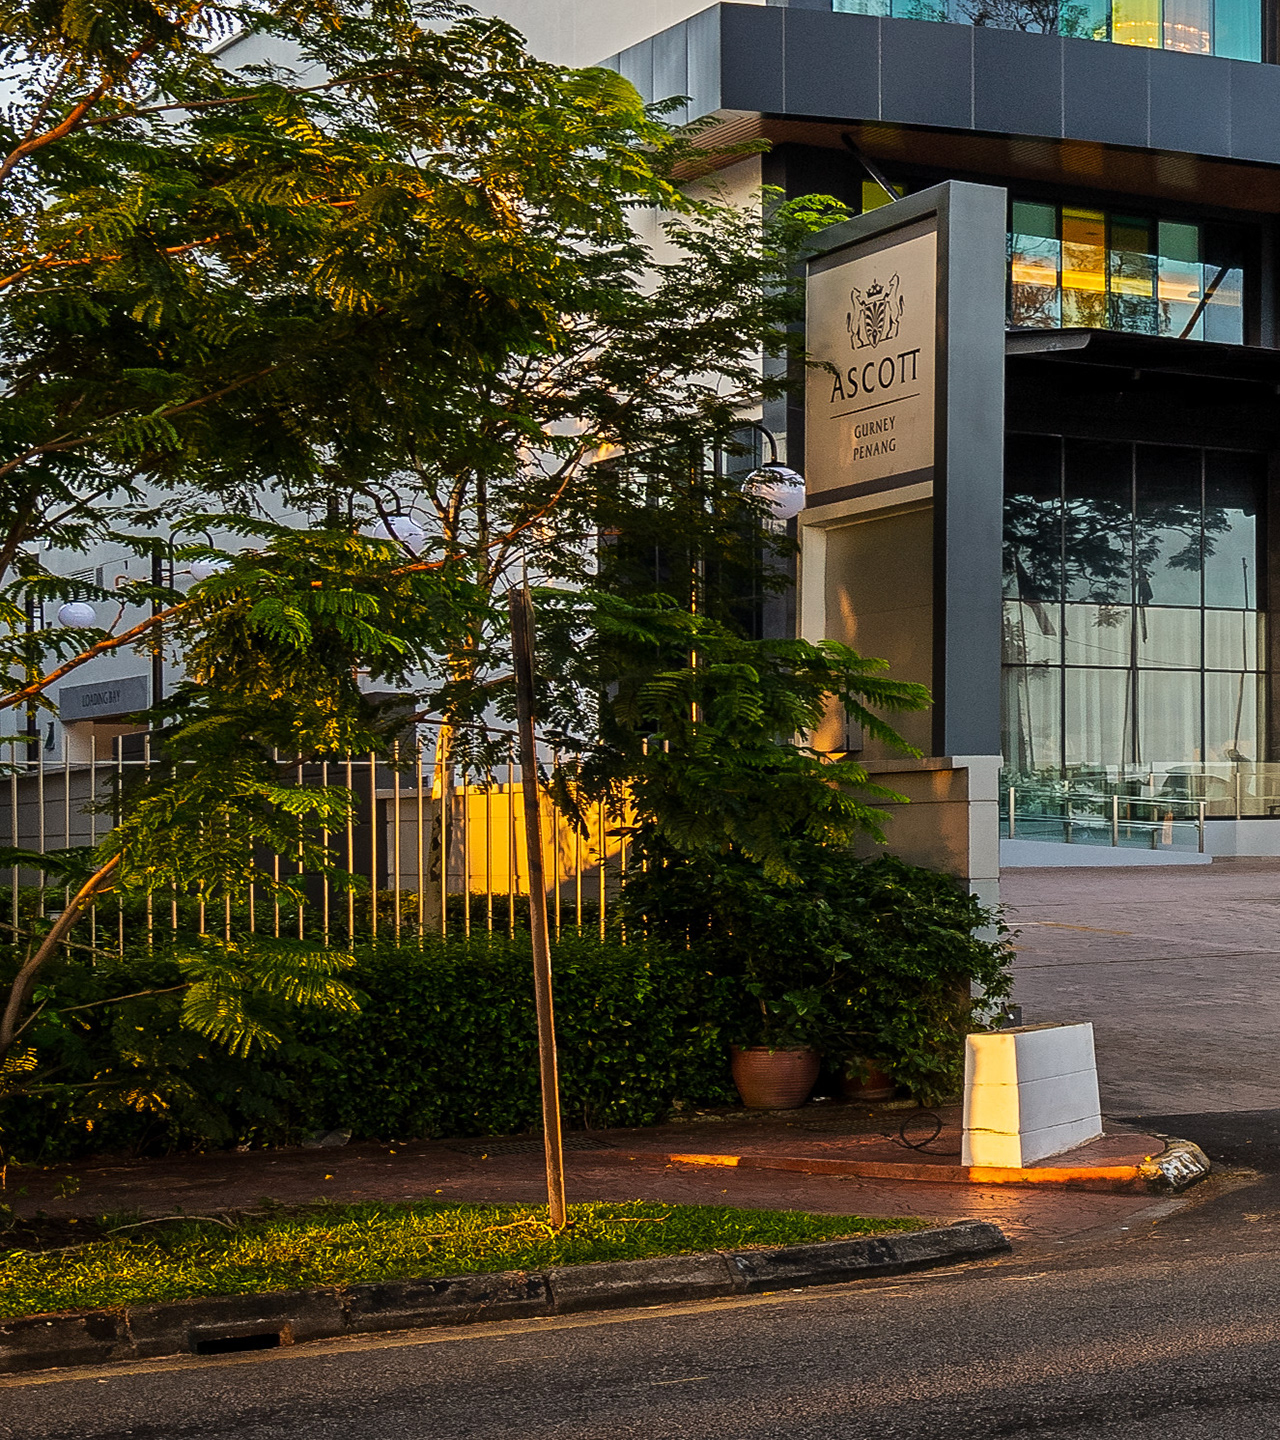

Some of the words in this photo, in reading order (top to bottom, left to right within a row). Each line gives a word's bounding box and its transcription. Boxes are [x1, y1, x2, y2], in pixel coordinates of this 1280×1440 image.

[830, 348, 921, 403] ASCOTT
[854, 416, 896, 439] GURNEY
[853, 438, 896, 461] PENANG
[82, 691, 107, 707] LOADING
[109, 689, 121, 704] BAY
